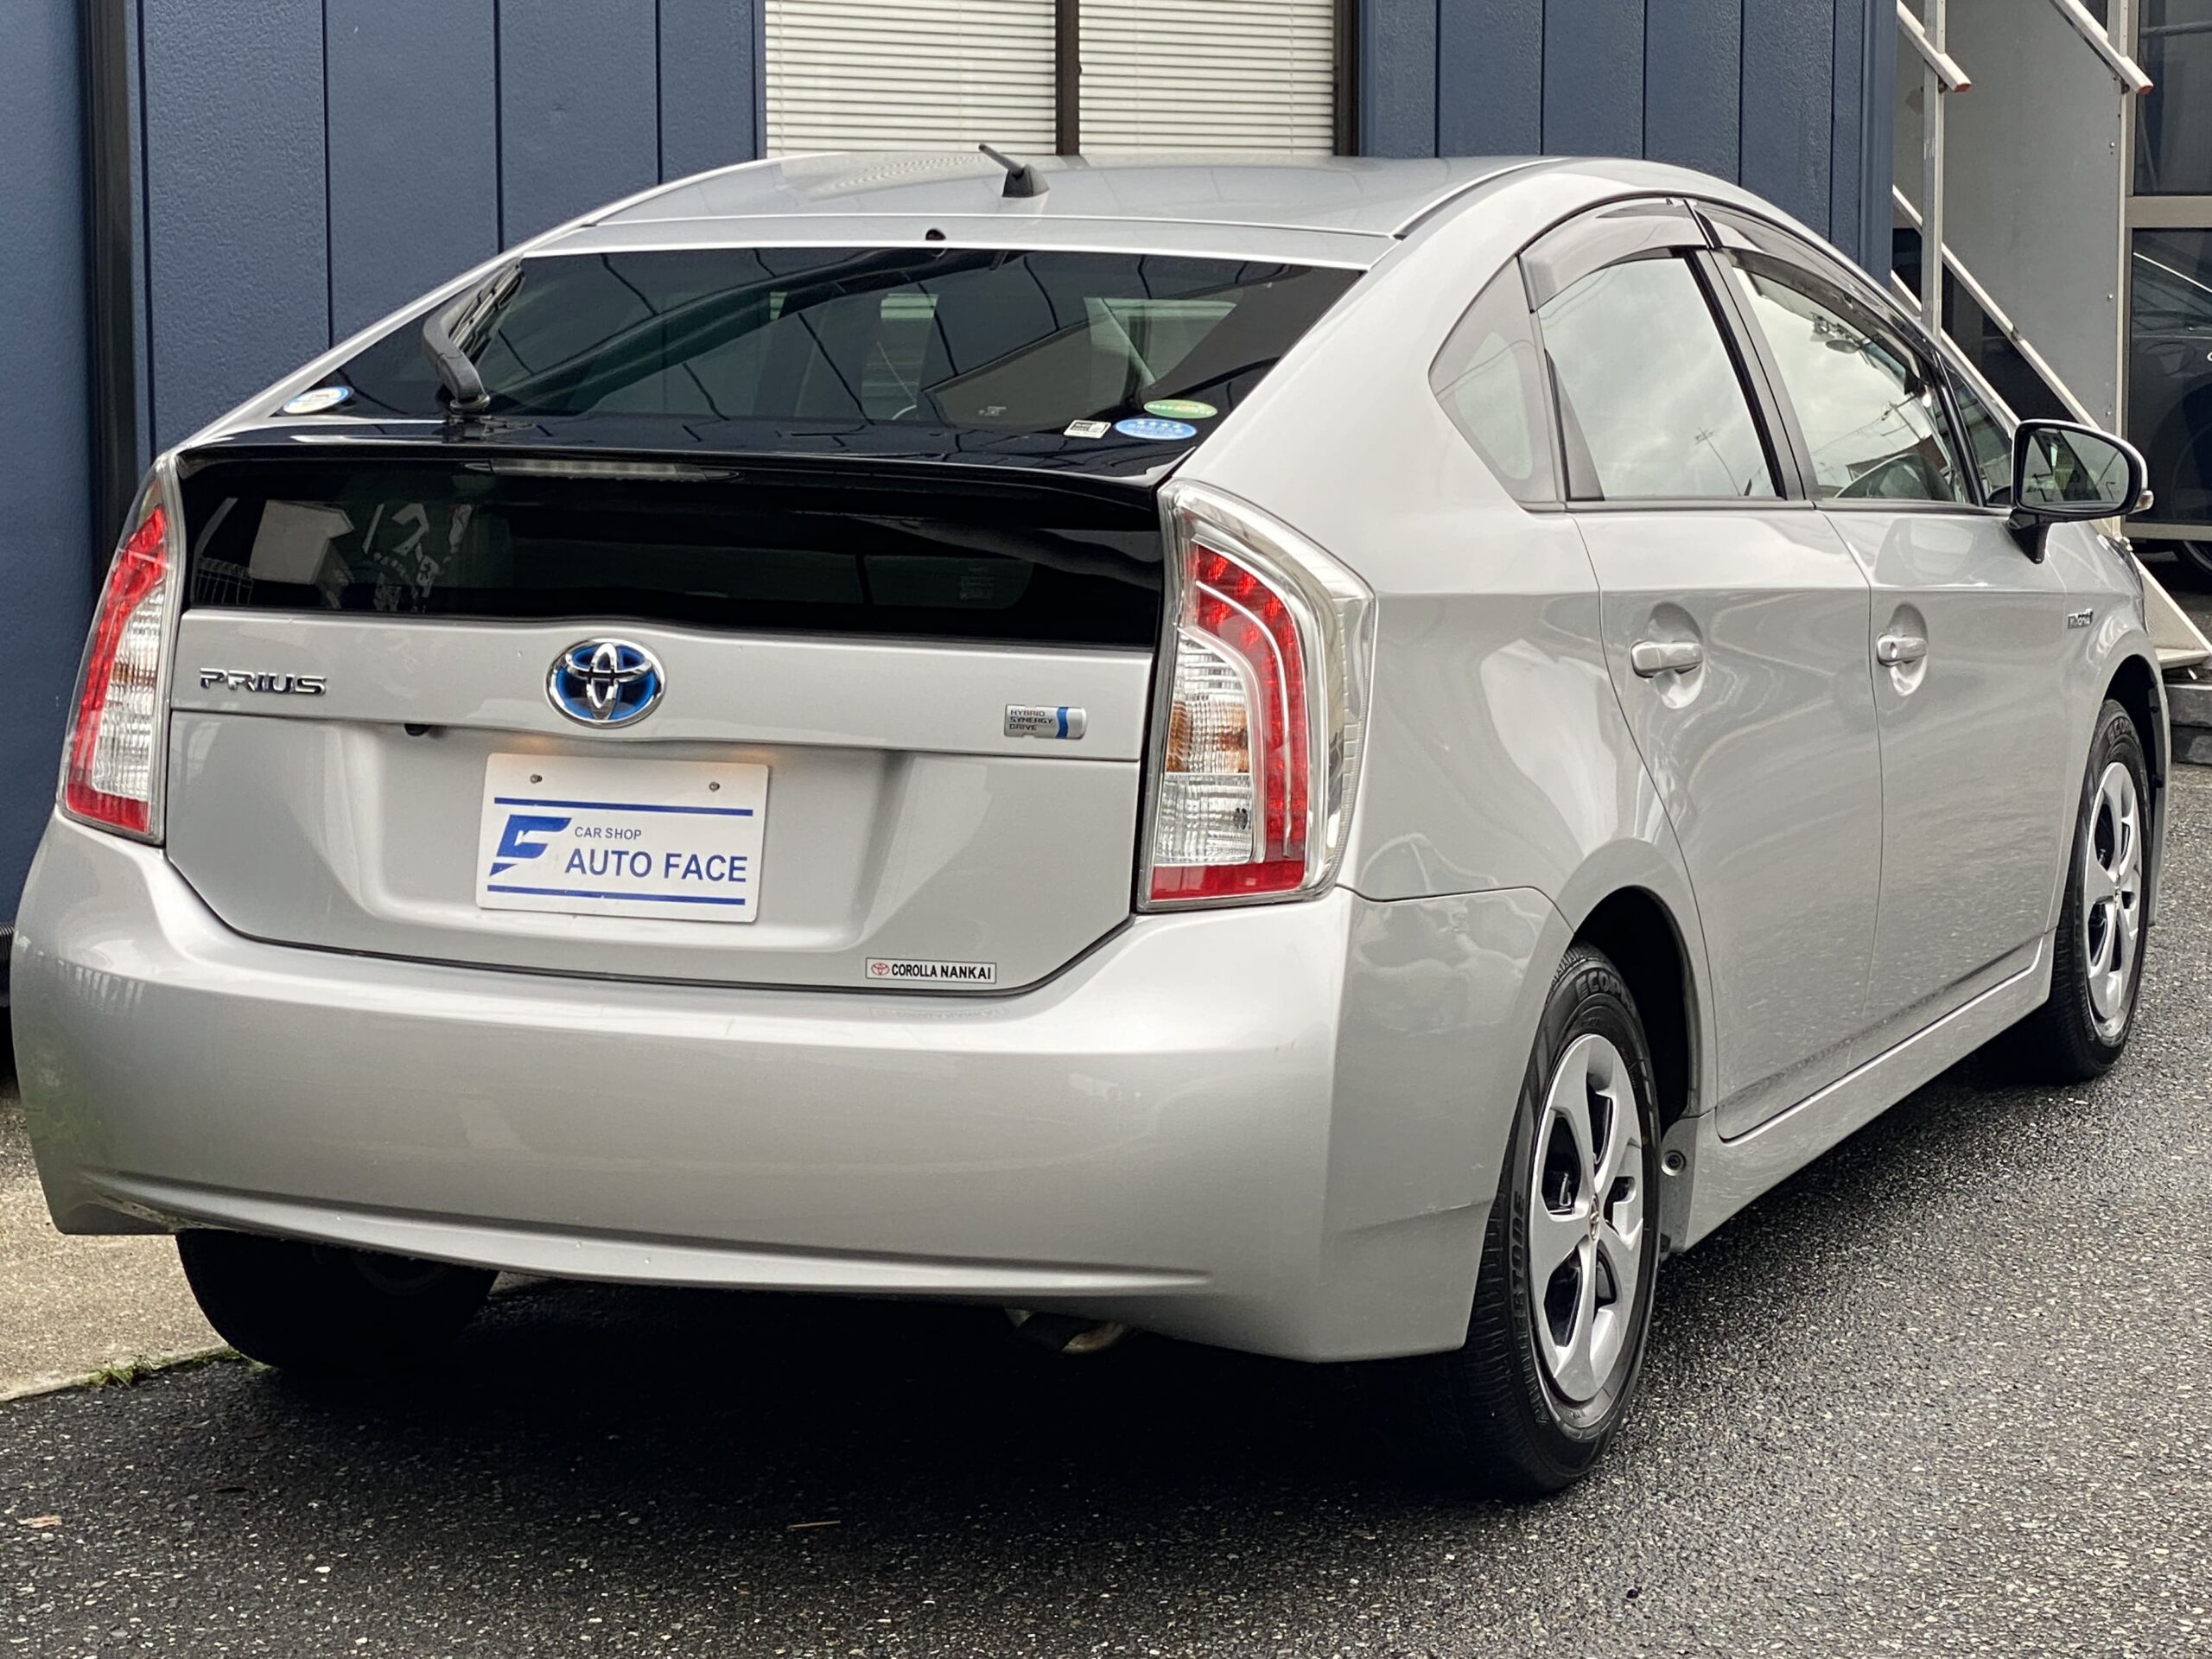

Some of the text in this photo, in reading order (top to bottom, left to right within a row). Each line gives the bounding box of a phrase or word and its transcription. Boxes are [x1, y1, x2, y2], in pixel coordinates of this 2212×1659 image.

[200, 667, 327, 696] PRIUS
[574, 826, 642, 840] CAR SHOP
[564, 848, 748, 882] AUTO FACE
[891, 963, 991, 980] COROLLA NANKAI
